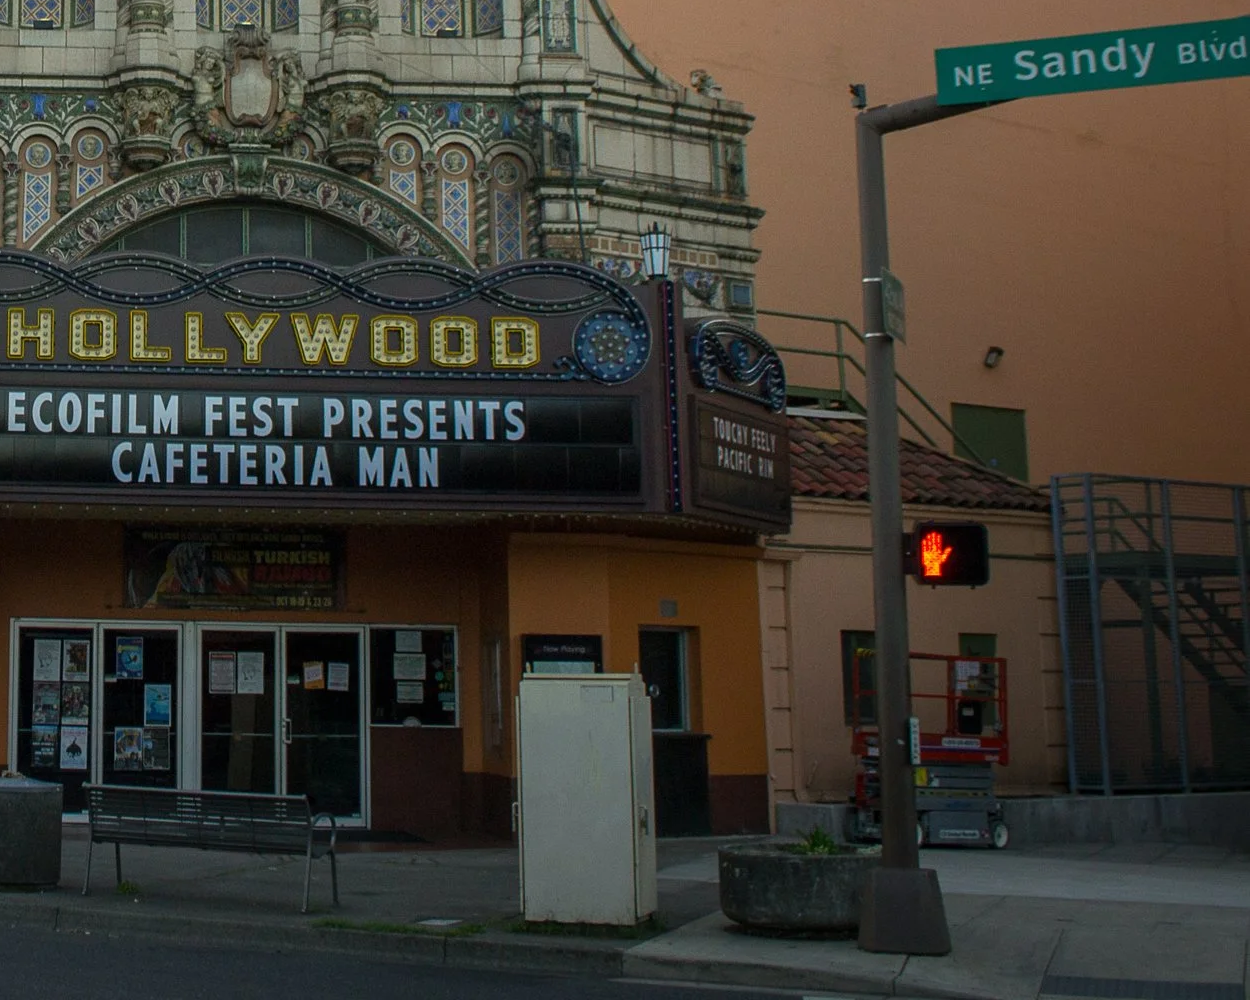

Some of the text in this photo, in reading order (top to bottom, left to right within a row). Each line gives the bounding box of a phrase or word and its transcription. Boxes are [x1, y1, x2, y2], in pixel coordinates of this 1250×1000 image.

[953, 35, 1248, 87] NE Sandy Blvd
[6, 306, 541, 369] HOLLYWOOD
[7, 391, 526, 441] ECOFILM FEST PRESENTS
[713, 416, 776, 453] TOUCHY FEELY
[111, 441, 439, 488] CAFETERIA MAN
[717, 445, 775, 480] PACIFIC RIM
[253, 550, 331, 565] TURKISH
